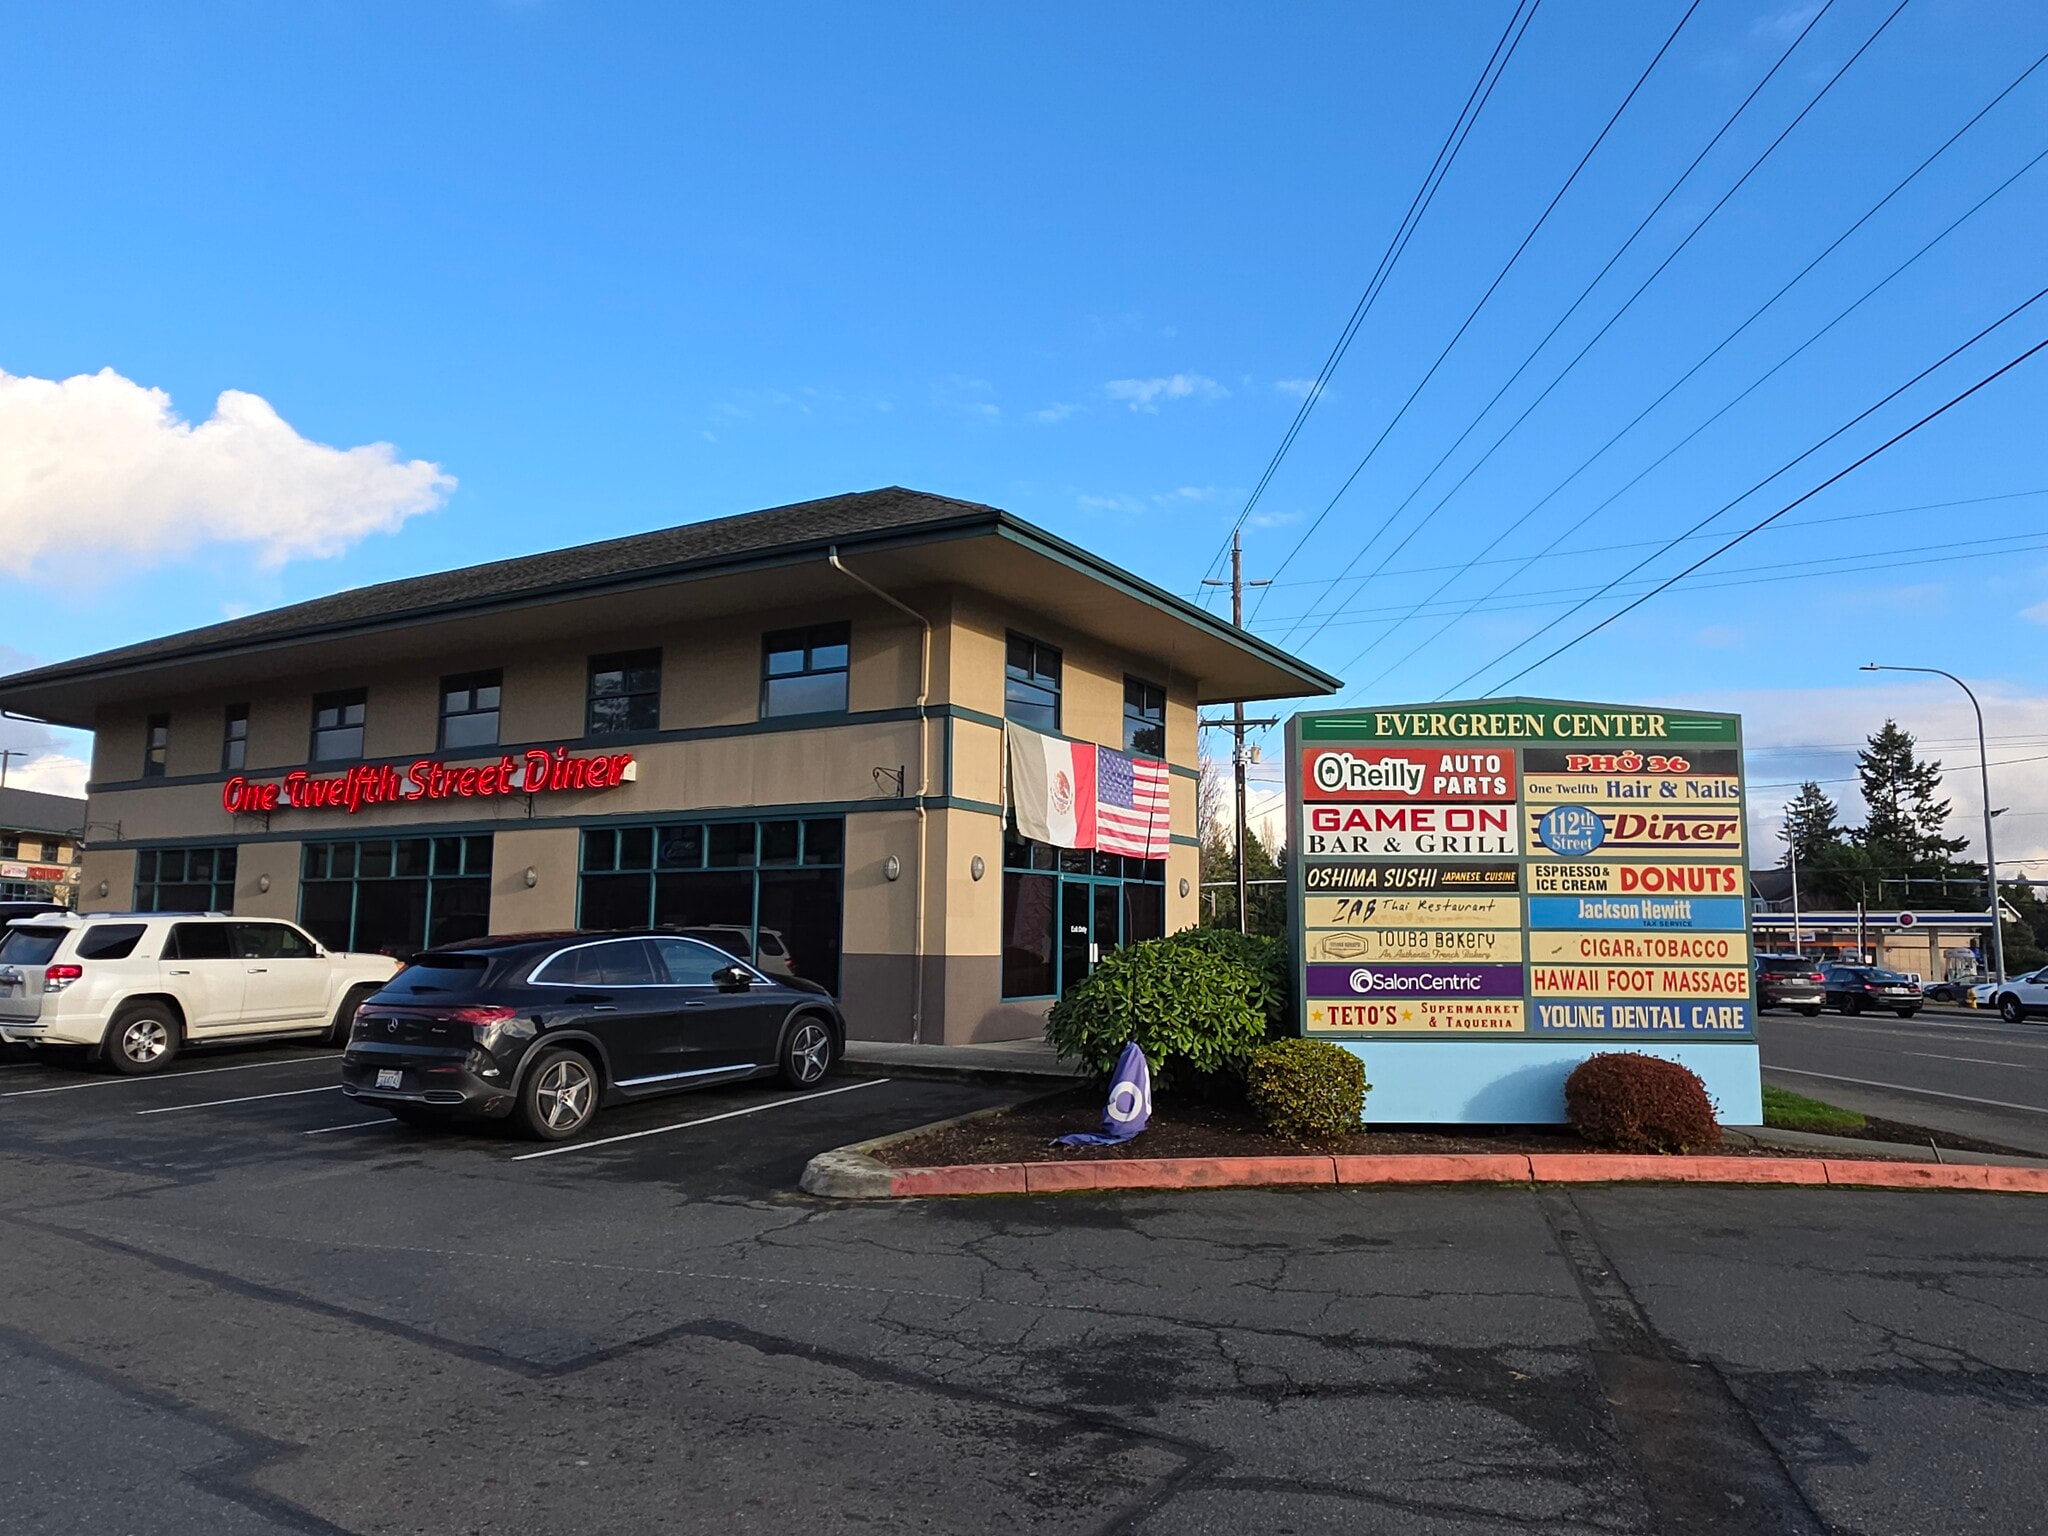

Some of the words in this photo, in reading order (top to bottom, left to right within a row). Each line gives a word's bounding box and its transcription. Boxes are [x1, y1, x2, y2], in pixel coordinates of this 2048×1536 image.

[1375, 713, 1544, 737] EVERGREEN
[1553, 713, 1667, 737] CENTER
[1316, 755, 1423, 792] O'Reilly
[1439, 754, 1501, 774] AUTO
[1648, 756, 1690, 772] 36
[223, 776, 279, 814] One
[285, 764, 400, 814] Twelfth
[405, 755, 516, 801] Street
[522, 746, 632, 792] Diner
[1433, 776, 1507, 796] PARTS
[1529, 783, 1552, 794] One
[1556, 783, 1599, 795] Twelfth
[1606, 780, 1652, 799] Hair
[1659, 780, 1678, 799] &
[1685, 780, 1741, 799] Nails
[1312, 808, 1436, 832] GAME
[1445, 808, 1507, 832] ON
[1613, 813, 1737, 841] Diner
[1308, 834, 1370, 854] BAR
[1383, 836, 1402, 853] &
[1415, 833, 1514, 854] GRILL
[1551, 836, 1593, 851] Street
[1307, 868, 1377, 888] OSHIMA
[1384, 868, 1438, 888] SUSHI
[1441, 871, 1482, 883] JAPANESE
[1484, 872, 1516, 882] CUISINE
[1535, 865, 1600, 878] ESPRESSO
[1603, 866, 1610, 877] &
[1620, 867, 1736, 892] DONUTS
[1536, 879, 1558, 891] ICE
[1562, 879, 1608, 891] CREAM
[1332, 899, 1377, 924] ZAB
[1383, 899, 1410, 911] Thai
[1418, 899, 1496, 912] Restaurant
[1578, 900, 1639, 920] Jackson
[1642, 900, 1692, 920] Hewitt
[1643, 920, 1657, 928] TAX
[1659, 920, 1693, 928] SERVICE
[1379, 949, 1391, 959] An
[1394, 949, 1430, 959] Authentic
[1432, 949, 1460, 959] French
[1462, 949, 1491, 959] Bakery
[1580, 938, 1635, 957] CIGAR
[1636, 946, 1643, 957] &
[1643, 939, 1728, 958] TOBACCO
[1373, 972, 1482, 991] SalonCentric
[1534, 969, 1599, 992] HAWAII
[1607, 970, 1655, 992] FOOT
[1662, 971, 1746, 993] MASSAGE
[1327, 1005, 1397, 1026] TETO'S
[1421, 1002, 1519, 1014] SUPERMARKET
[1538, 1005, 1605, 1028] YOUNG
[1612, 1006, 1685, 1029] DENTAL
[1691, 1006, 1745, 1029] CARE
[1428, 1016, 1437, 1028] &
[1446, 1016, 1513, 1029] TAQUERIA
